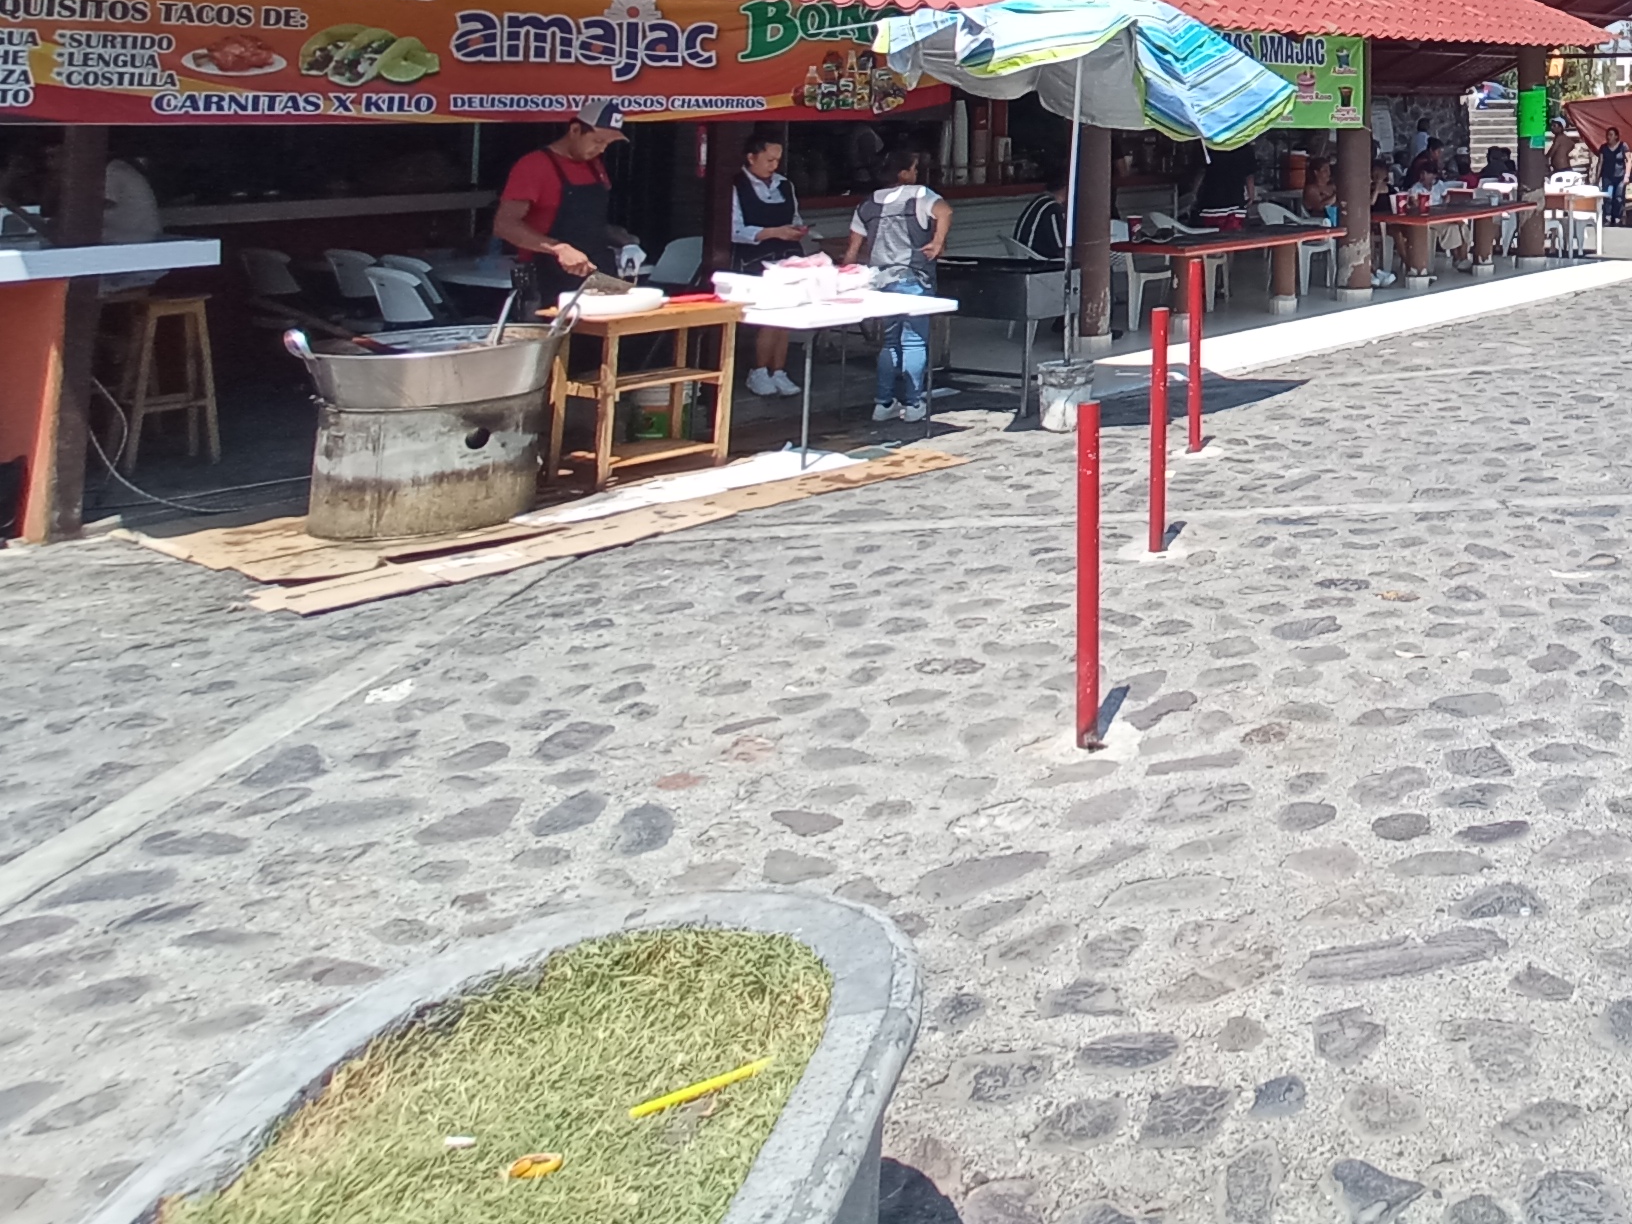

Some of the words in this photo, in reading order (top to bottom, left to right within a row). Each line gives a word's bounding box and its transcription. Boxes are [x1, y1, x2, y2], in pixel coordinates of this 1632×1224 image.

[159, 1, 255, 28] TACOS
[261, 7, 308, 30] DE:
[67, 32, 174, 52] SURTIDO
[451, 10, 717, 82] amajac
[1259, 33, 1326, 66] AMAJAC
[66, 51, 160, 69] LENGUA
[64, 70, 178, 88] COSTILLA
[152, 93, 324, 115] CARNITAS
[329, 94, 357, 113] X
[362, 94, 437, 114] KILO
[451, 94, 566, 111] DELISIOSOS
[569, 95, 585, 111] Y
[669, 95, 767, 111] CHAMORROS
